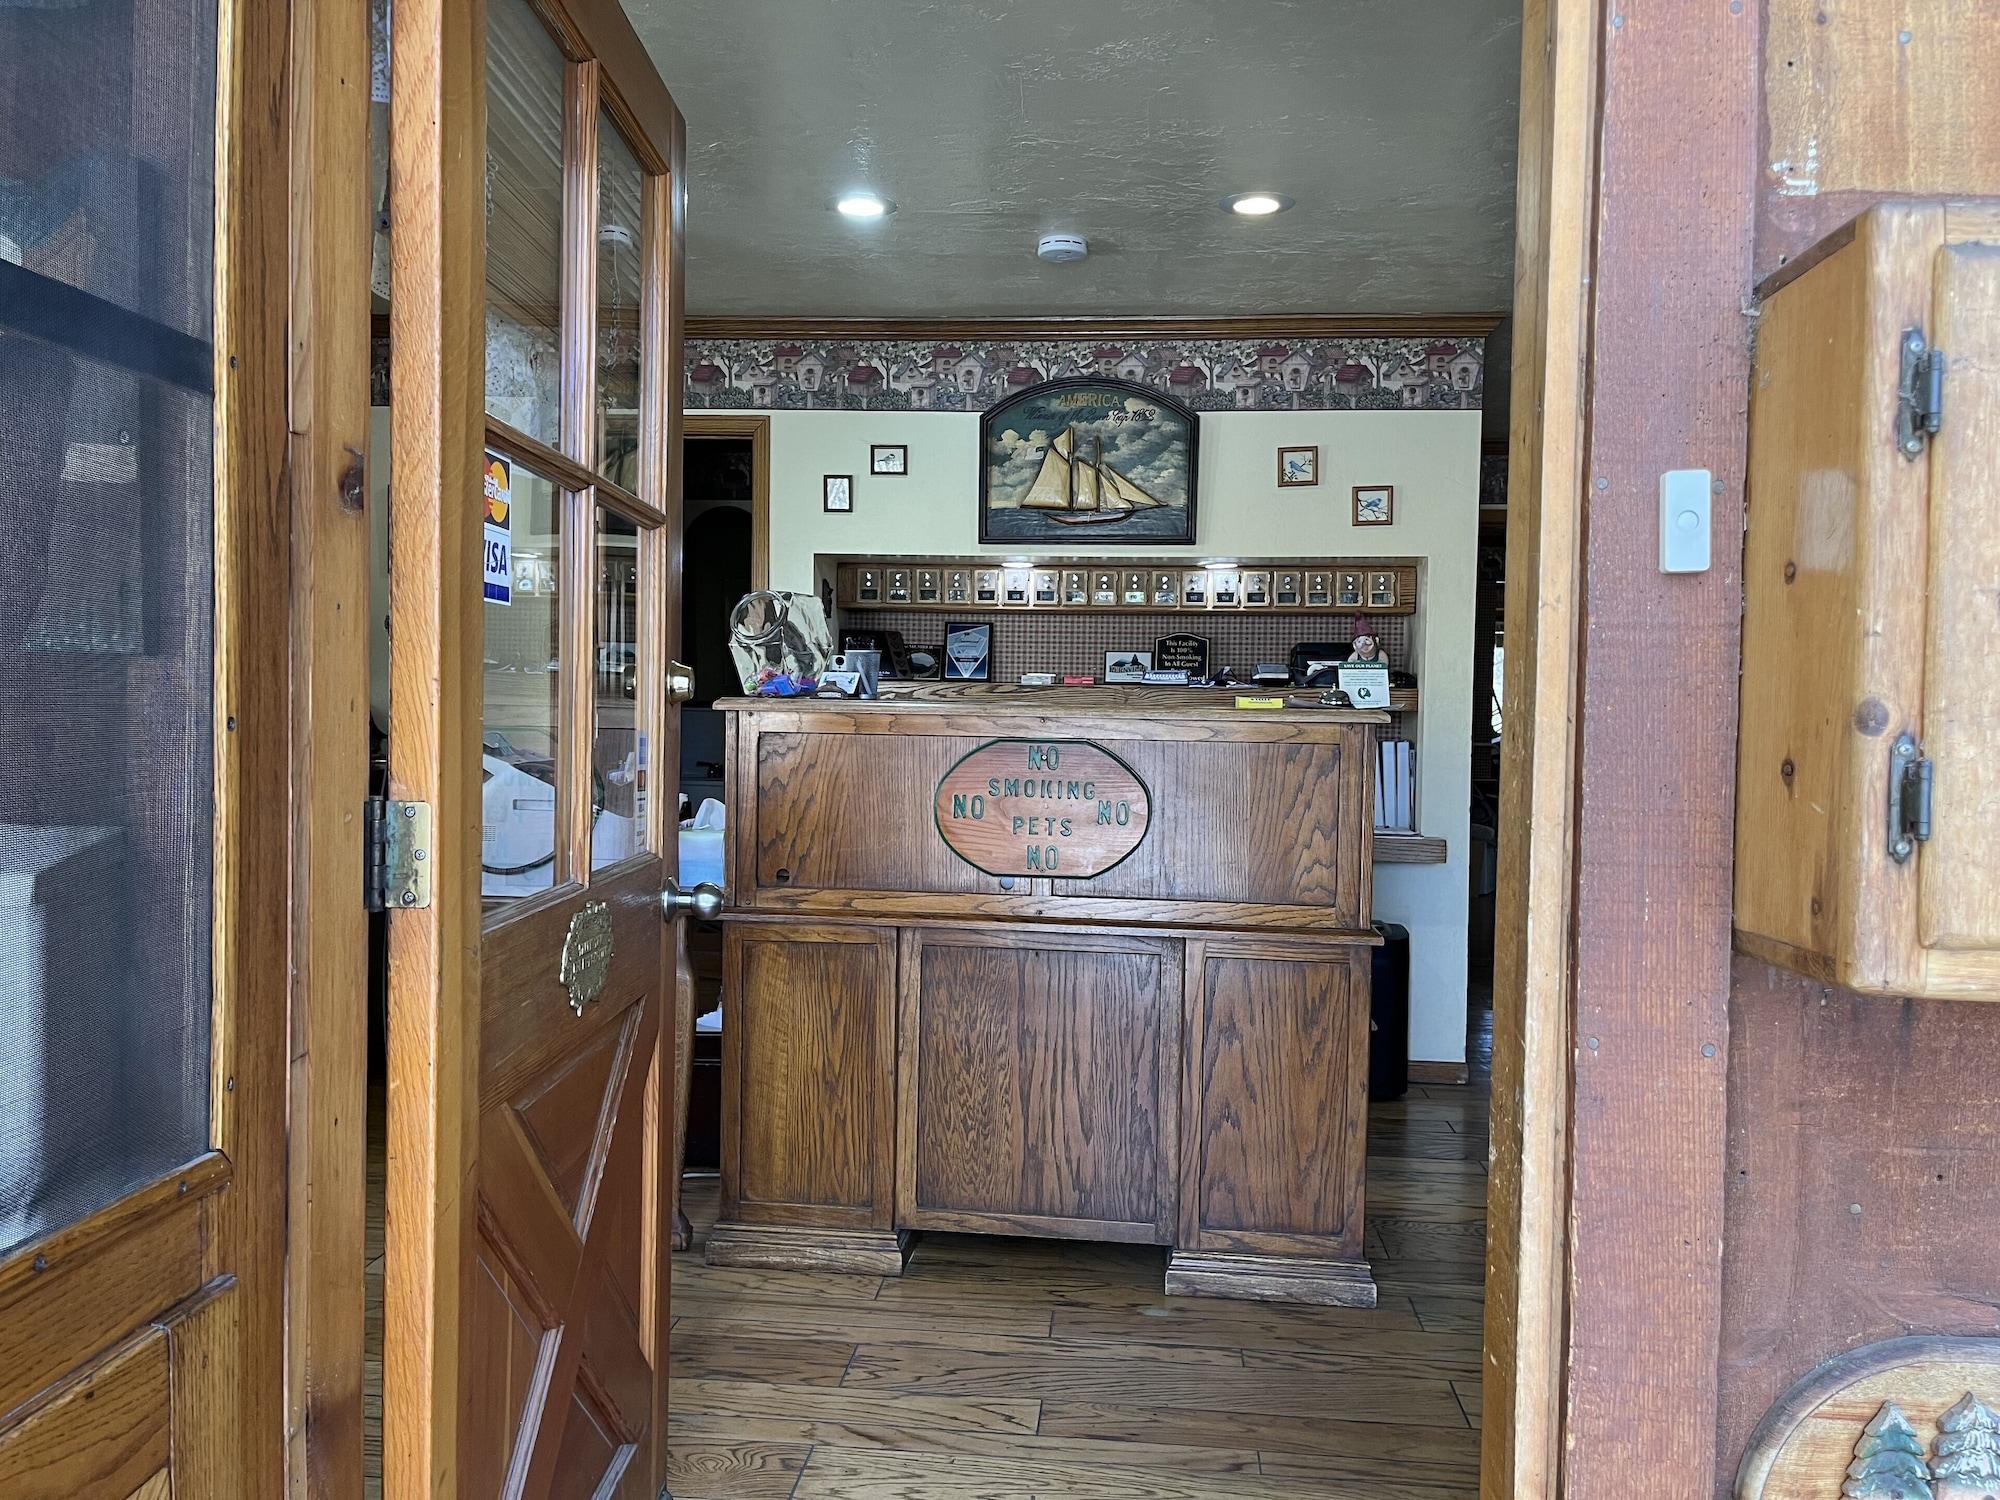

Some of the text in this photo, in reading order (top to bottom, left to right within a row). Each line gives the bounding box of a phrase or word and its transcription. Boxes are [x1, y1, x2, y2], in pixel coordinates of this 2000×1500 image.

[1058, 393, 1120, 407] AMERICA
[1028, 745, 1060, 771] NO
[988, 778, 1095, 800] SMOKING
[953, 794, 985, 820] NO
[1097, 800, 1130, 826] NO
[1012, 816, 1073, 837] PETS
[1027, 845, 1060, 871] NO
